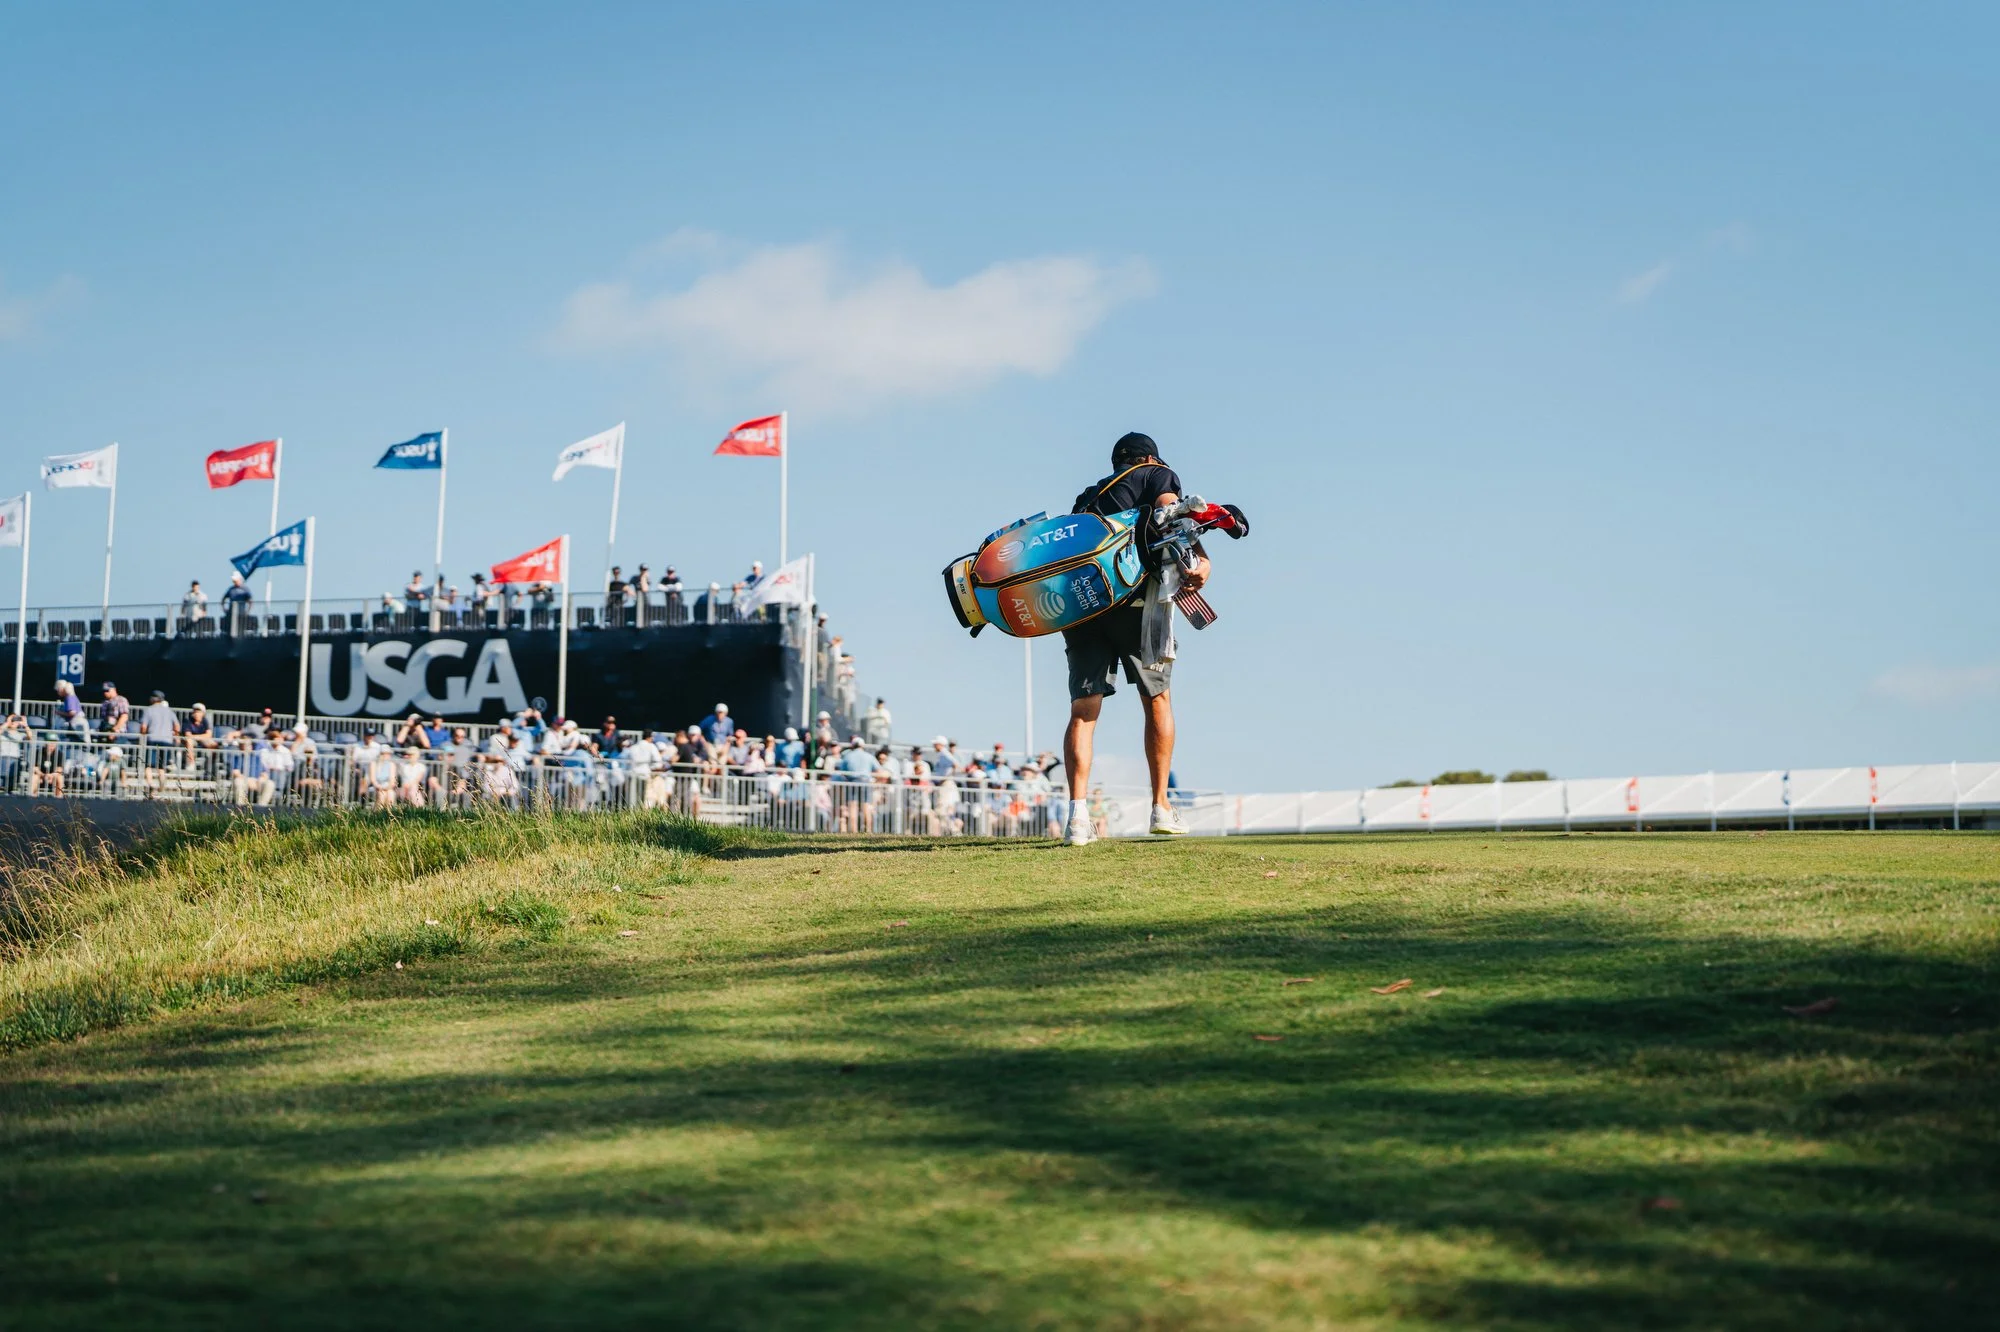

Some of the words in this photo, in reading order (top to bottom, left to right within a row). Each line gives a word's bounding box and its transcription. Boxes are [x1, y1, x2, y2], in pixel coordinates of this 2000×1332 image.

[1027, 523, 1079, 550] AT&T
[1071, 579, 1091, 610] Spieth
[1081, 575, 1100, 608] Jordan
[1011, 598, 1036, 628] AT&T
[58, 653, 84, 675] 18
[310, 638, 530, 717] USGA
